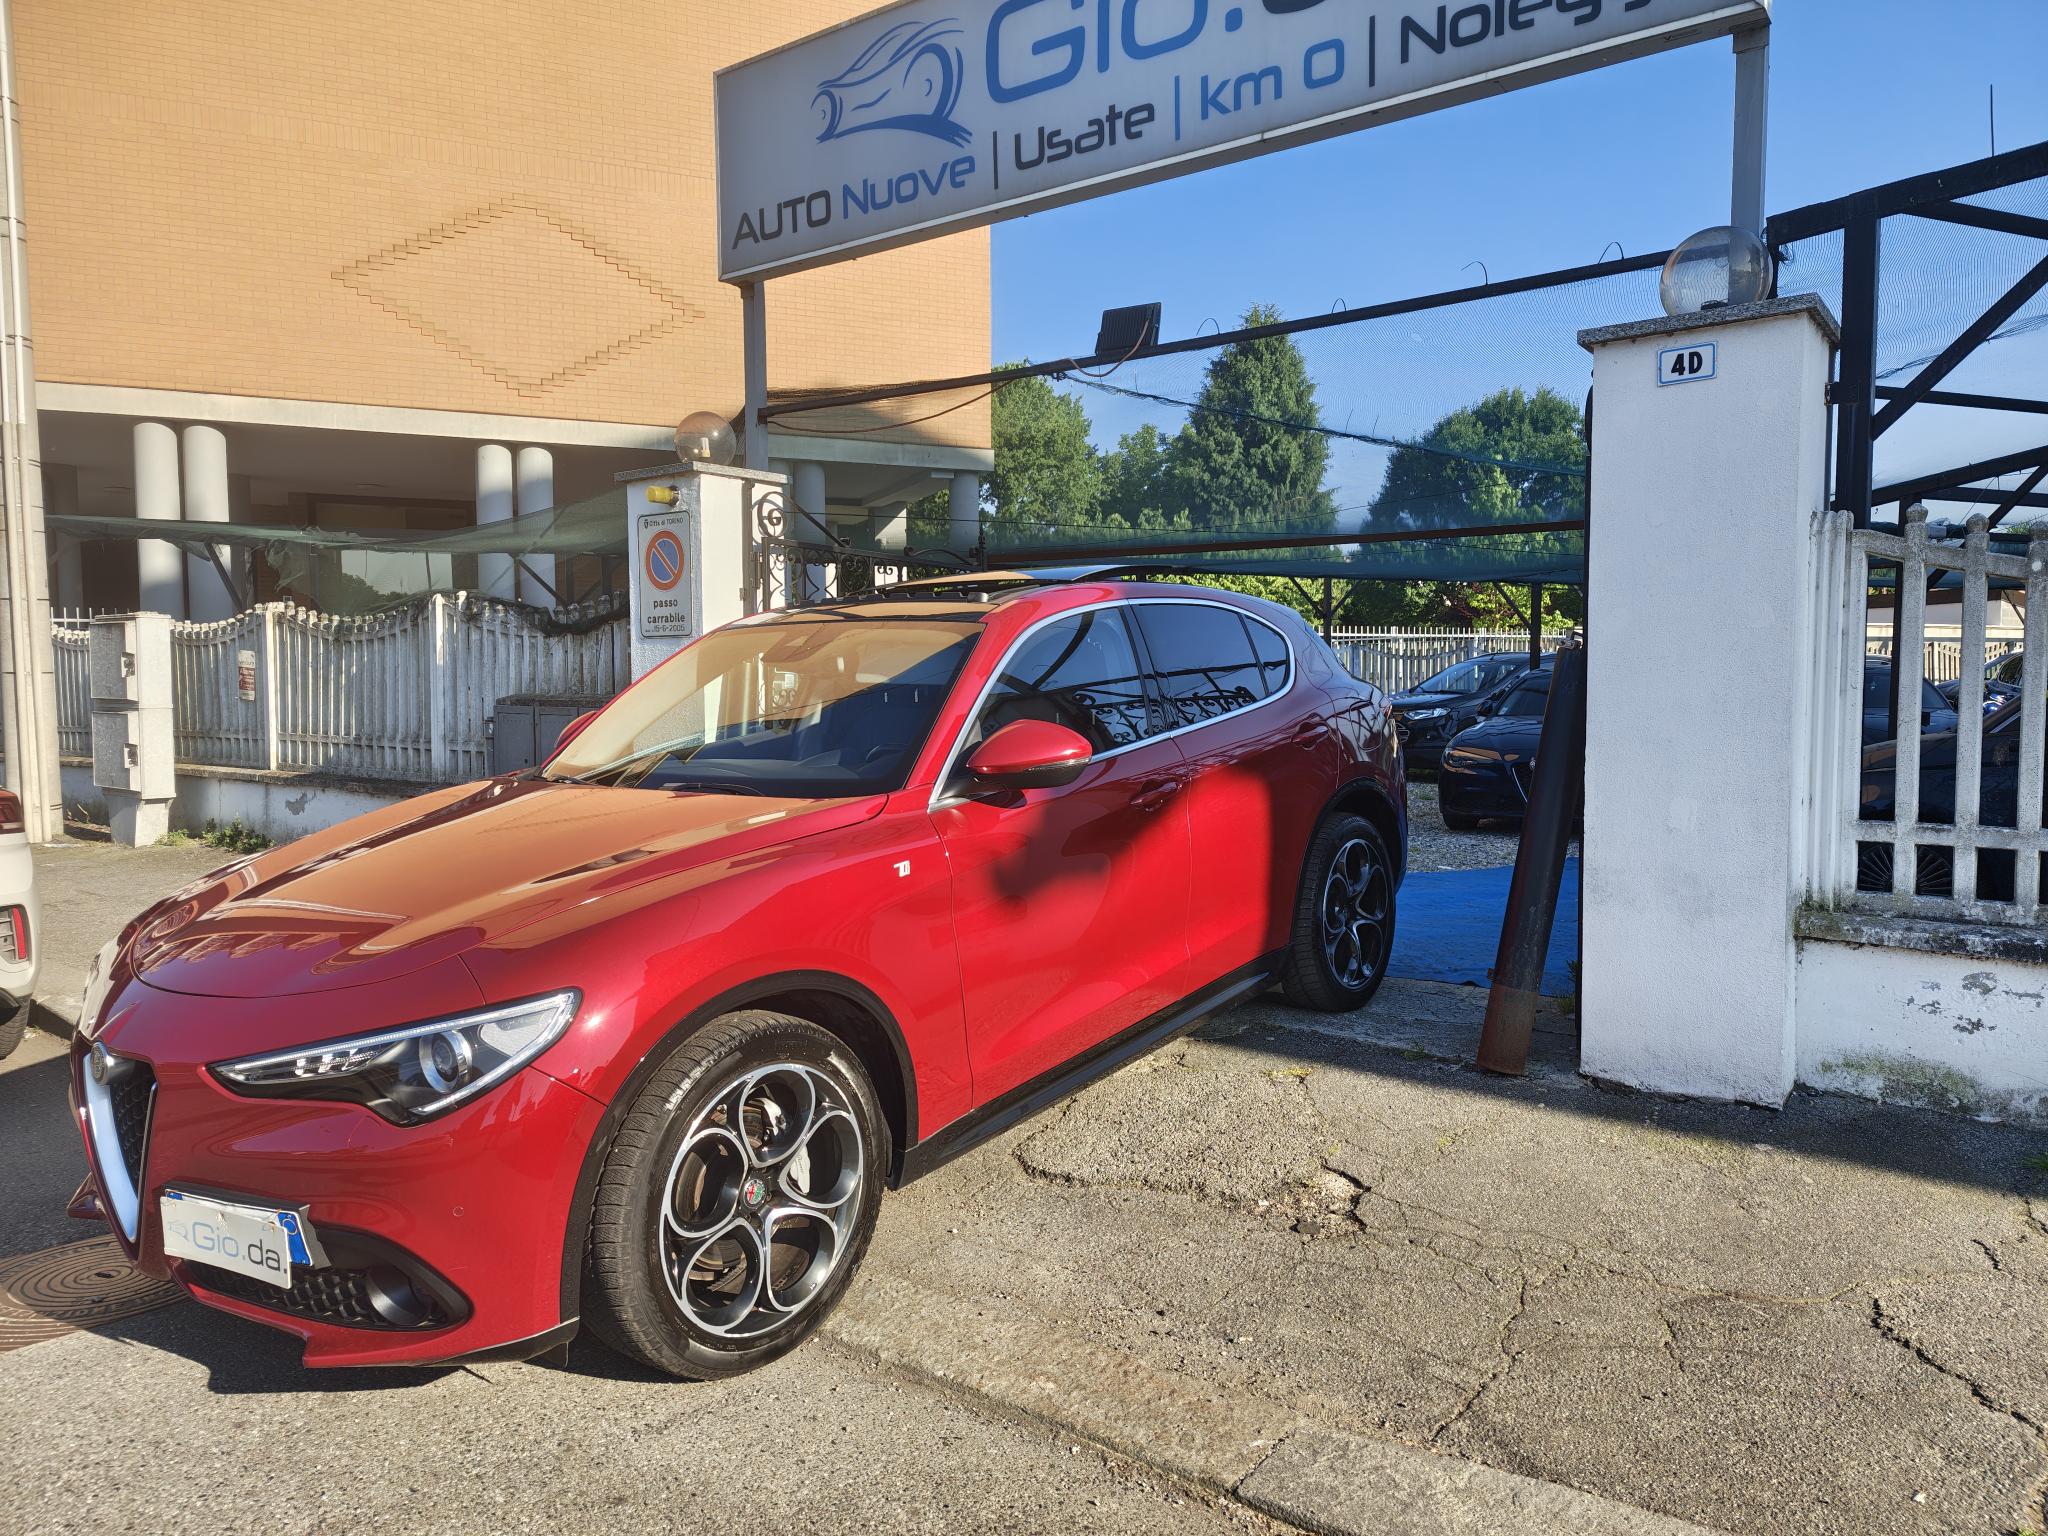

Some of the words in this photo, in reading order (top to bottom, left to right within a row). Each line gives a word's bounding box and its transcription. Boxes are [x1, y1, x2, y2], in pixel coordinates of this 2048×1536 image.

[731, 188, 832, 251] AUTO
[842, 154, 976, 221] Nuove
[1013, 102, 1156, 171] Usate
[1200, 64, 1282, 121] km
[1671, 351, 1703, 376] 4D
[653, 599, 678, 610] passo
[647, 612, 686, 624] carrabile
